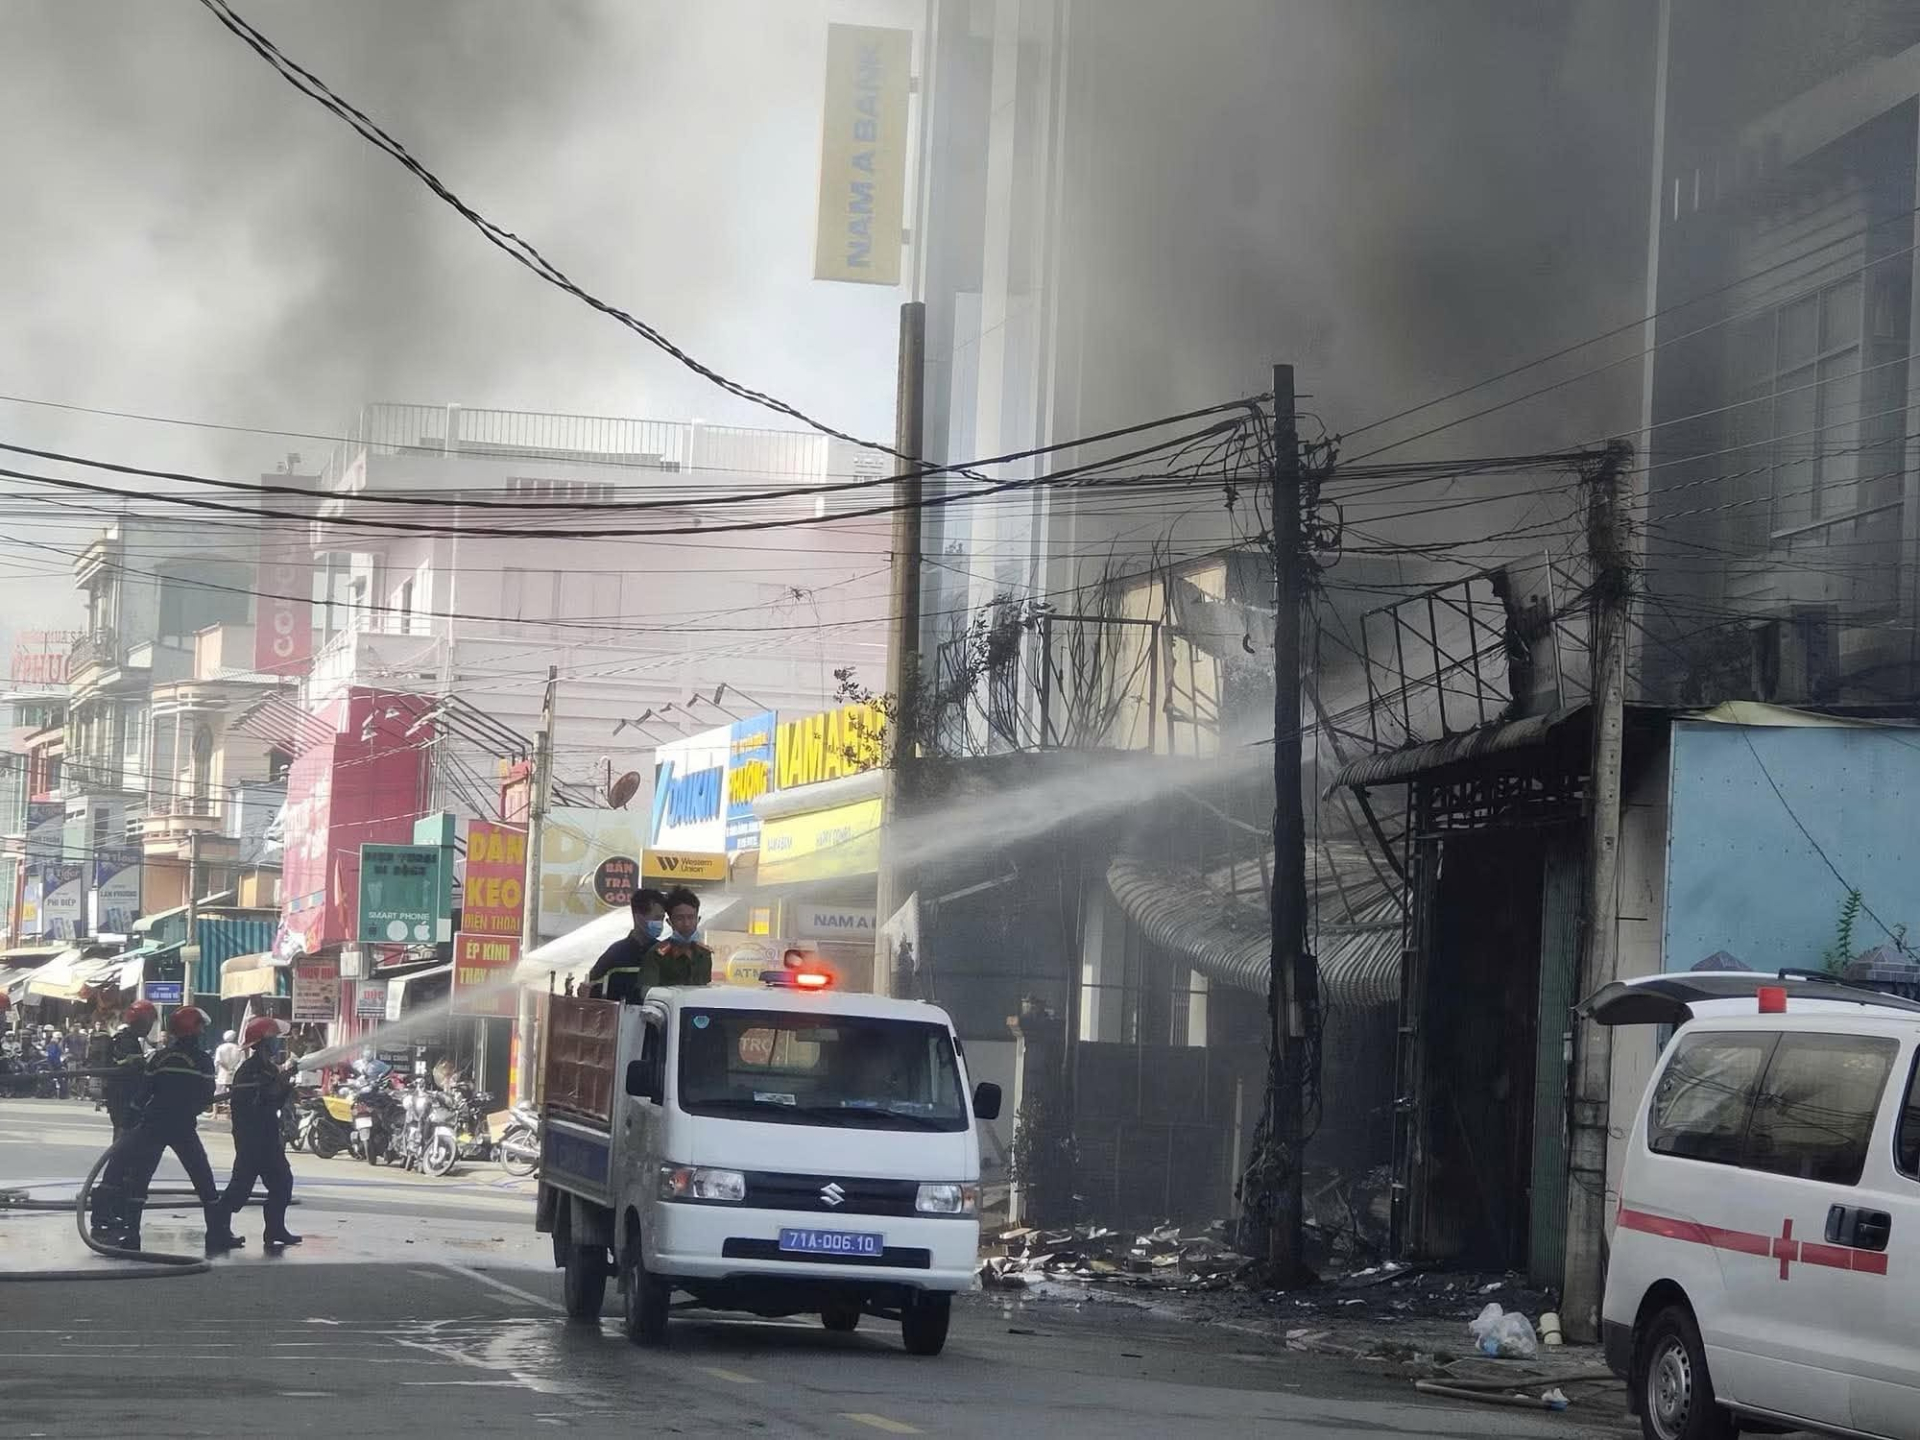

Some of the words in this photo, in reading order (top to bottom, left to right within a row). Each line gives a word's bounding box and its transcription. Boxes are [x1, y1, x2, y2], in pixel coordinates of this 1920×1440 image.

[853, 43, 886, 143] BANK
[851, 150, 876, 175] A
[845, 181, 876, 268] NAM
[777, 713, 825, 789] NAM
[468, 830, 526, 866] DÁN
[606, 861, 633, 873] BÁN
[681, 857, 713, 867] Western
[466, 877, 521, 909] KEO
[368, 911, 398, 919] SMART
[400, 912, 430, 920] PHONE
[814, 913, 853, 928] NAM
[857, 914, 870, 929] A
[790, 1232, 874, 1252] 71A-006.10
